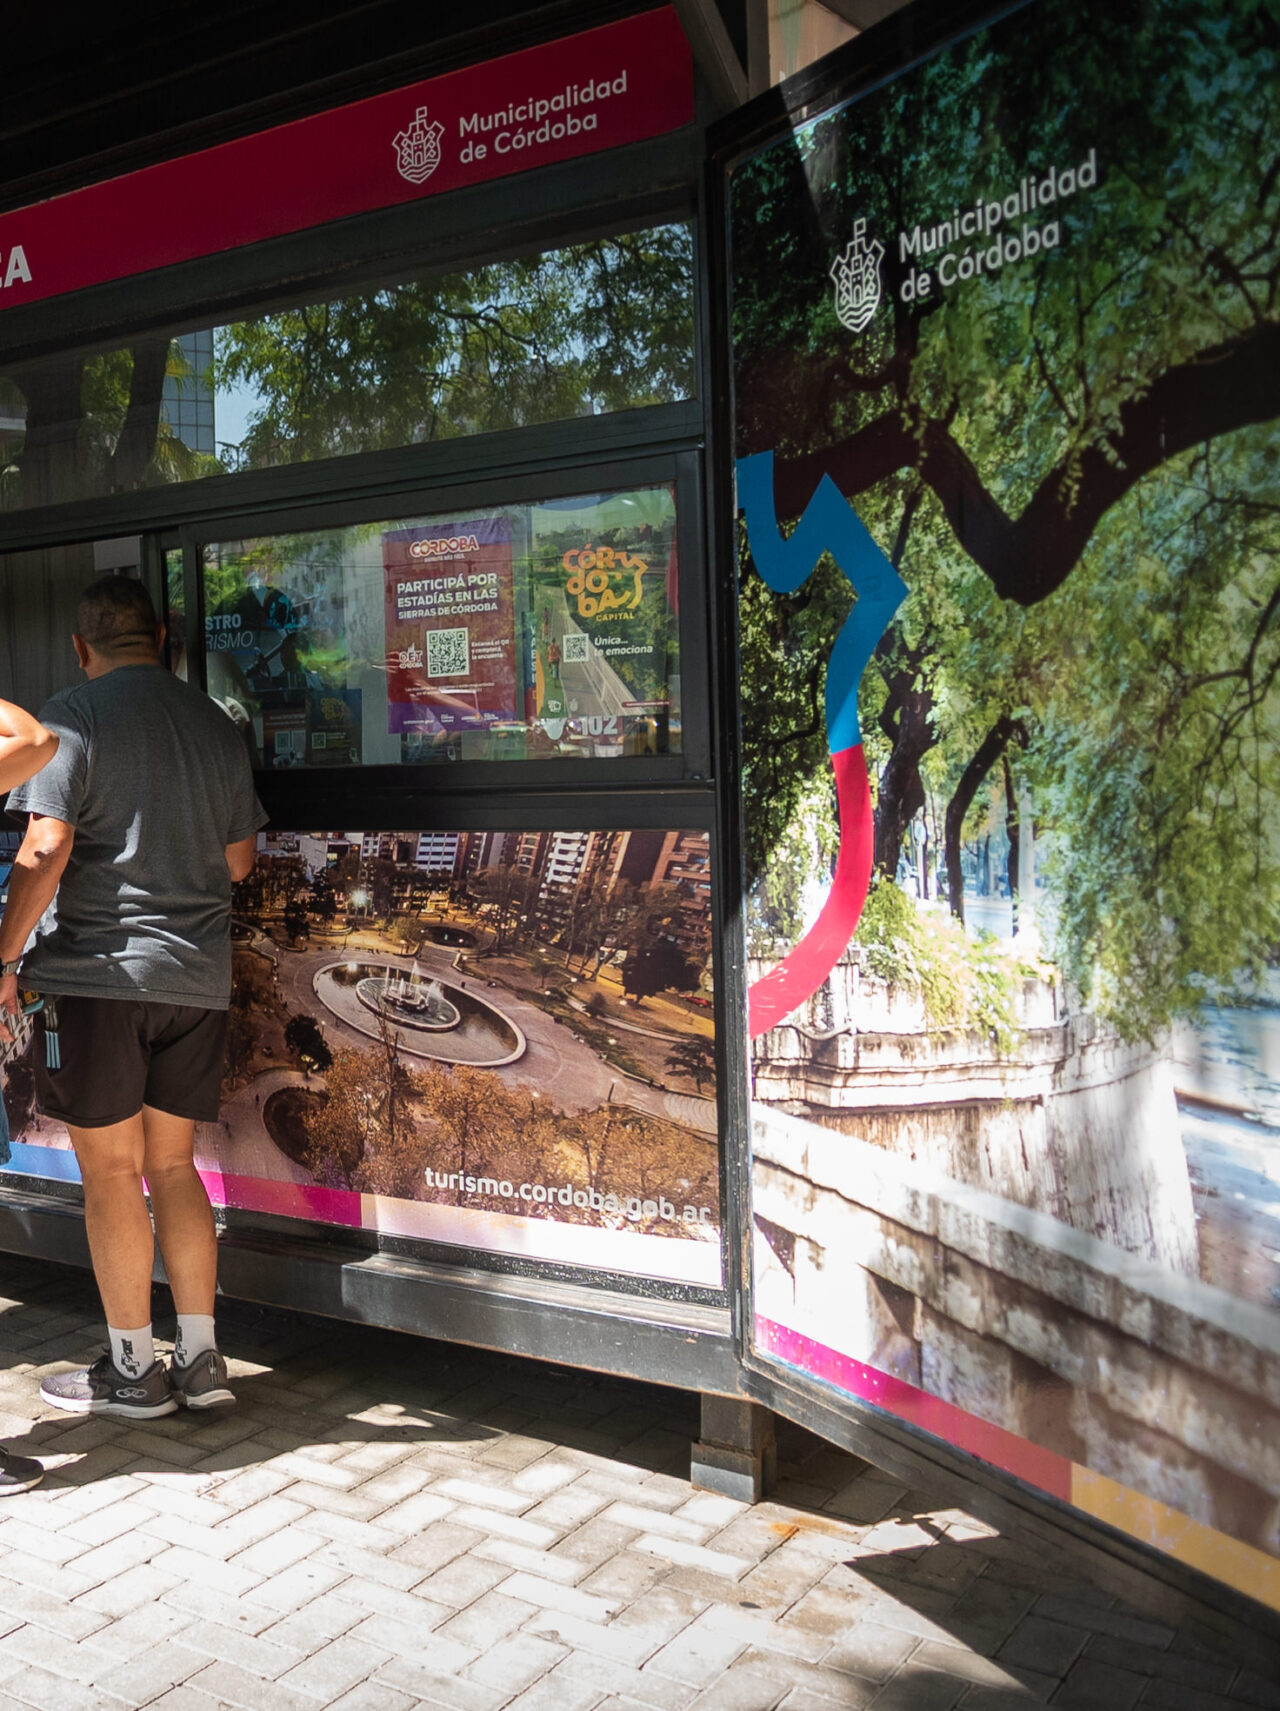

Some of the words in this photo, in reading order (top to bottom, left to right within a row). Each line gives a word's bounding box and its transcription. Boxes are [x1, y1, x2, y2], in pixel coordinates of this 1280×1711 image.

[459, 70, 628, 137] Municipalidad
[459, 141, 488, 164] de
[494, 113, 598, 154] Córdoba
[899, 147, 1097, 263] Municipalidad
[900, 268, 931, 303] de
[938, 221, 1060, 287] Córdoba
[397, 573, 465, 594] PARTICIPÁ
[467, 572, 497, 587] POR
[397, 592, 454, 608] ESTADÍAS
[455, 591, 472, 602] EN
[473, 588, 498, 600] LAS
[398, 607, 436, 620] SIERRAS
[437, 605, 450, 616] DE
[451, 602, 498, 615] CÓRDOBA
[595, 612, 635, 621] CAPITAL
[606, 645, 653, 657] emociona
[424, 1166, 712, 1223] turismo.cordoba.gob.ar
